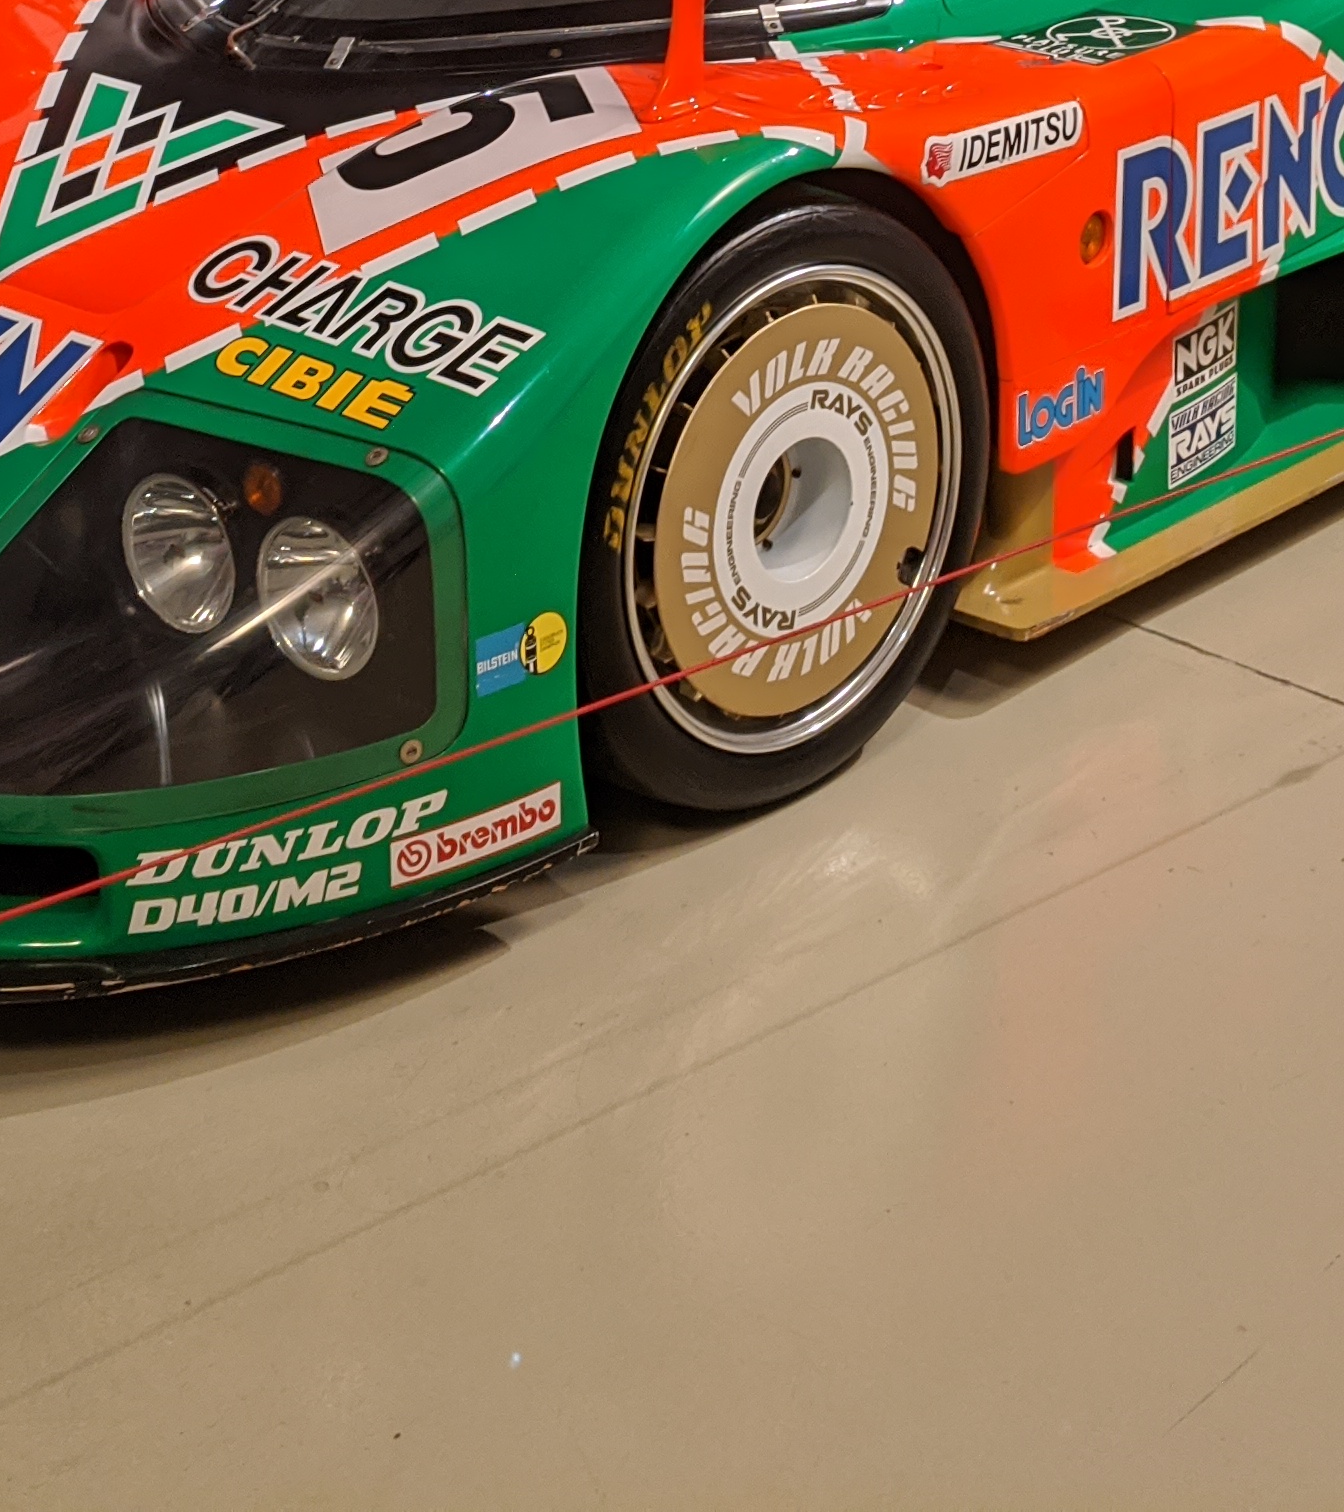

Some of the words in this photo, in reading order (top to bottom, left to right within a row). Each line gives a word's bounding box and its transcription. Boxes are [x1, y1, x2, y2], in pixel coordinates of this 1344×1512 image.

[959, 105, 1079, 172] IDEMITSU
[187, 234, 546, 397] CHARGE
[1177, 310, 1234, 384] NGK
[1176, 374, 1206, 398] SPARK
[1208, 353, 1234, 379] PLUGS
[731, 338, 840, 418] VOLK
[838, 346, 919, 513] RACING
[1171, 401, 1236, 464] RAYS
[1171, 431, 1235, 479] ENGINEERING
[810, 389, 873, 438] RAYS
[863, 436, 878, 540] ENGINEERING
[725, 478, 743, 589] ENGINEERING
[729, 587, 797, 631] RAYS
[476, 648, 519, 676] BILSTEIN
[125, 789, 448, 887] DUNLOP
[436, 795, 557, 864] brembo
[128, 861, 362, 935] D40/M2
